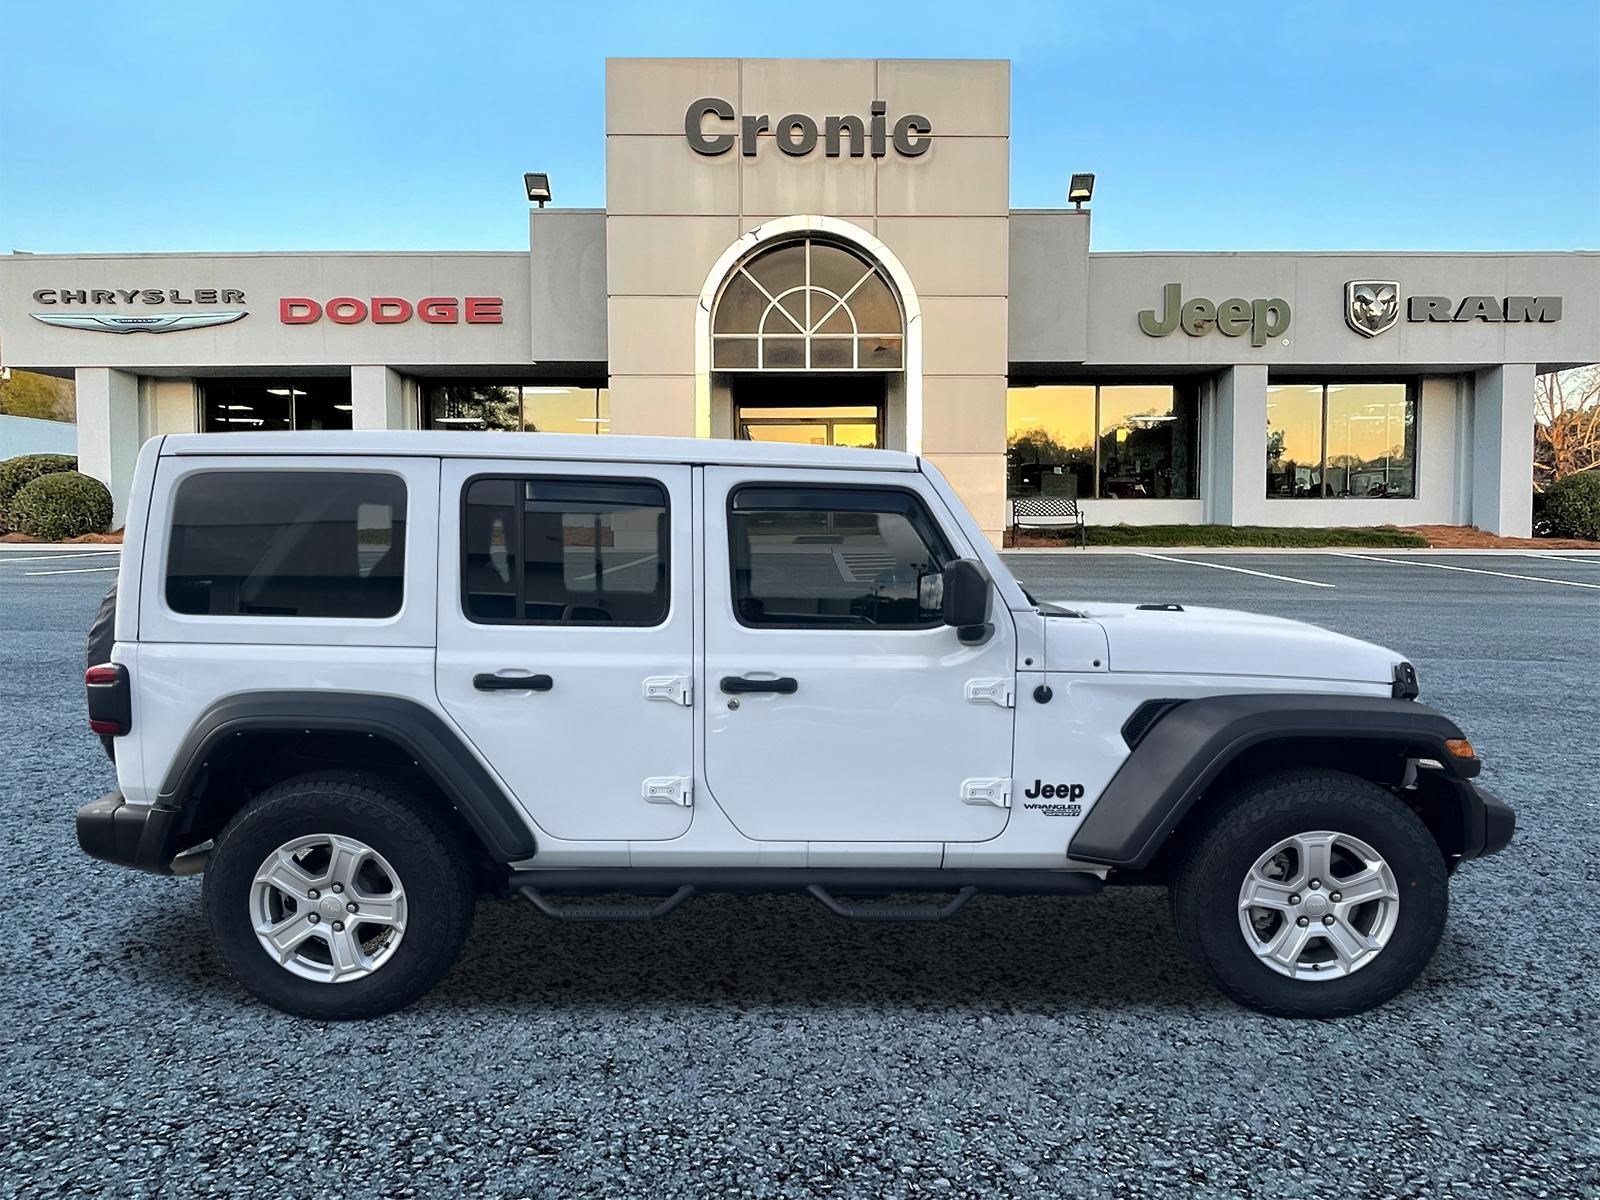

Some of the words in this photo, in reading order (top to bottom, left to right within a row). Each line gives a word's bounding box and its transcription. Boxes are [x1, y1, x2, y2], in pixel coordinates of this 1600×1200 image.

[685, 97, 932, 157] Cronic
[32, 288, 247, 305] CHRYSLER
[1407, 296, 1562, 322] RAM
[280, 297, 503, 324] DODGE
[1138, 283, 1291, 347] Jeep
[1025, 779, 1085, 802] Jeep
